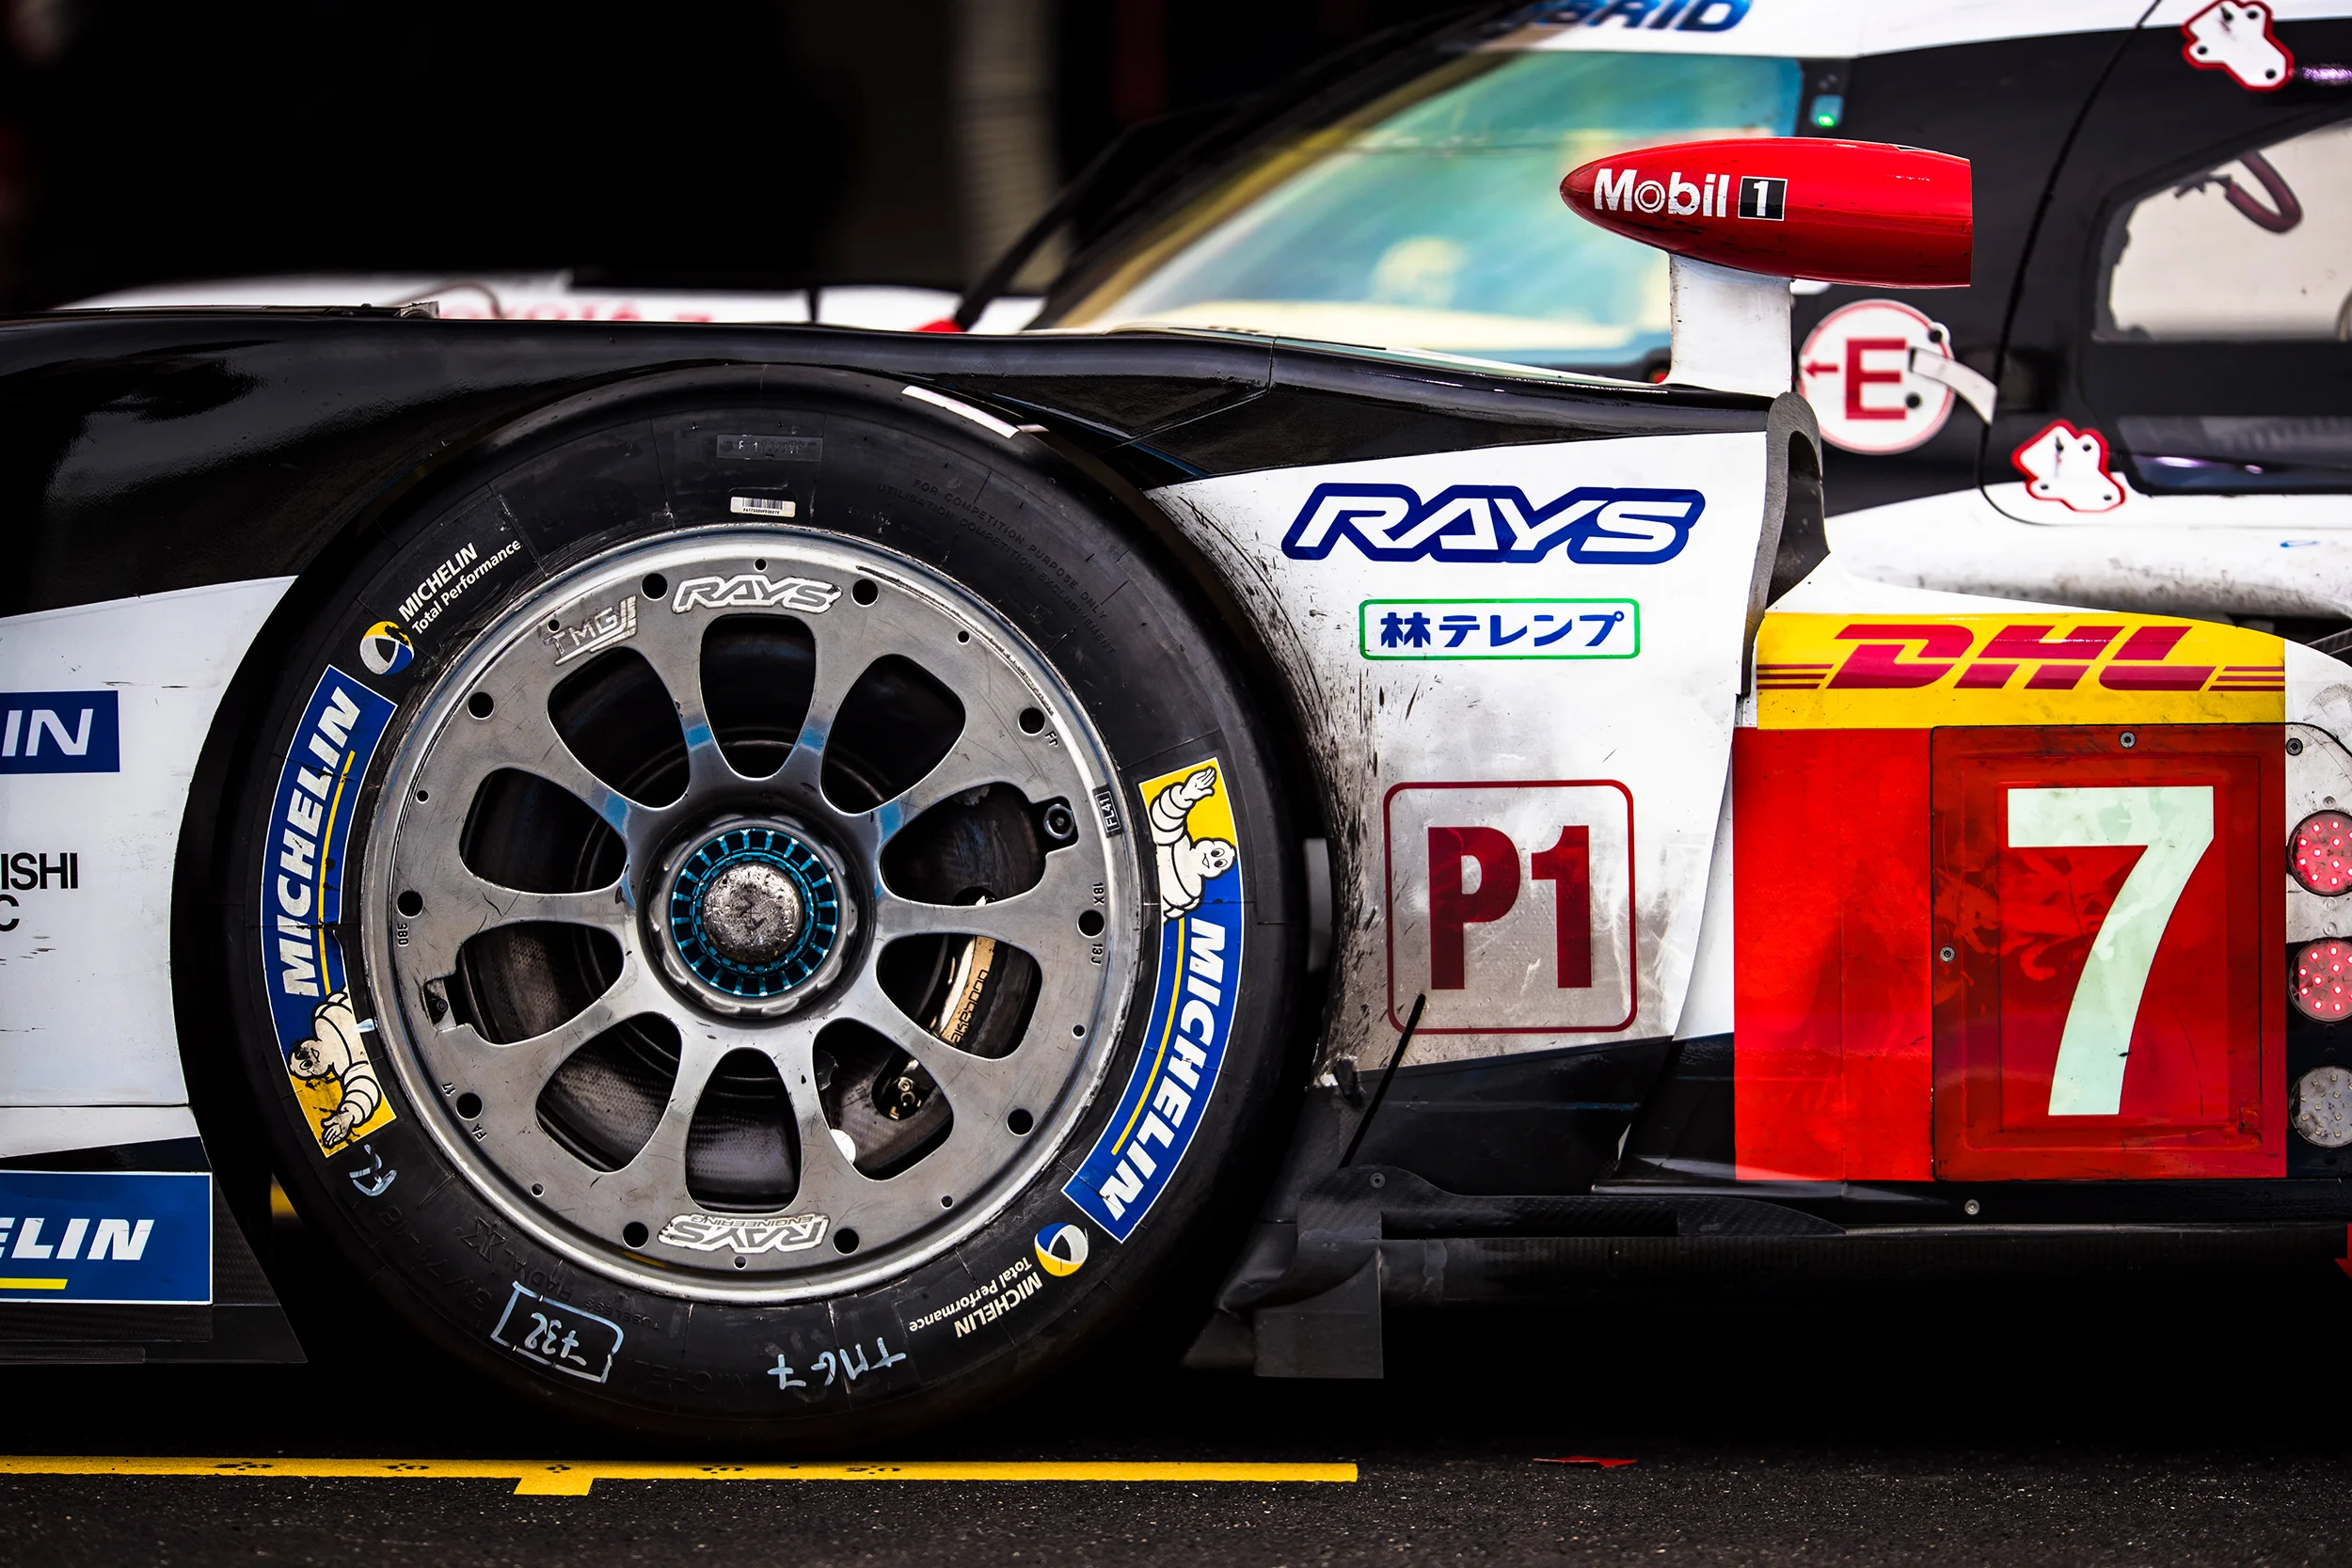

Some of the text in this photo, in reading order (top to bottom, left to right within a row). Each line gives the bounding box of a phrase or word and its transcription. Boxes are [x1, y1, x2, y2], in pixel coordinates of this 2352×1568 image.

[1594, 167, 1770, 217] Mobil 1
[1845, 338, 1907, 420] E
[912, 479, 940, 498] FOR
[943, 491, 1025, 546] COMPETITION
[1025, 542, 1079, 591] PURPOSE
[1077, 589, 1108, 622] ONLY
[1286, 486, 1701, 560] RAYS
[398, 542, 478, 622] MICHELIN
[412, 540, 521, 635] Total Performance
[674, 575, 840, 613] RAYS
[876, 482, 955, 521] UTILISATION
[958, 515, 1037, 573] COMPETITION
[1037, 570, 1118, 657] EXCLUSIVEMENT
[1380, 610, 1625, 648] 林テレンプ
[1826, 624, 2217, 691] DHL
[2, 708, 93, 756] IN
[1045, 730, 1059, 747] Fr
[277, 686, 361, 997] MICHELIN
[1098, 797, 1118, 830] FL41
[1, 851, 78, 890] ISHI
[1427, 825, 1592, 990] P1
[2007, 785, 2215, 1116] 7
[1101, 917, 1226, 1221] MICHELIN
[662, 1220, 824, 1252] RAYS
[691, 1214, 812, 1227] ENGINEERING
[909, 1256, 1033, 1332] Total Performance
[954, 1271, 1043, 1338] MICHELIN
[767, 1337, 907, 1389] TMG 7
